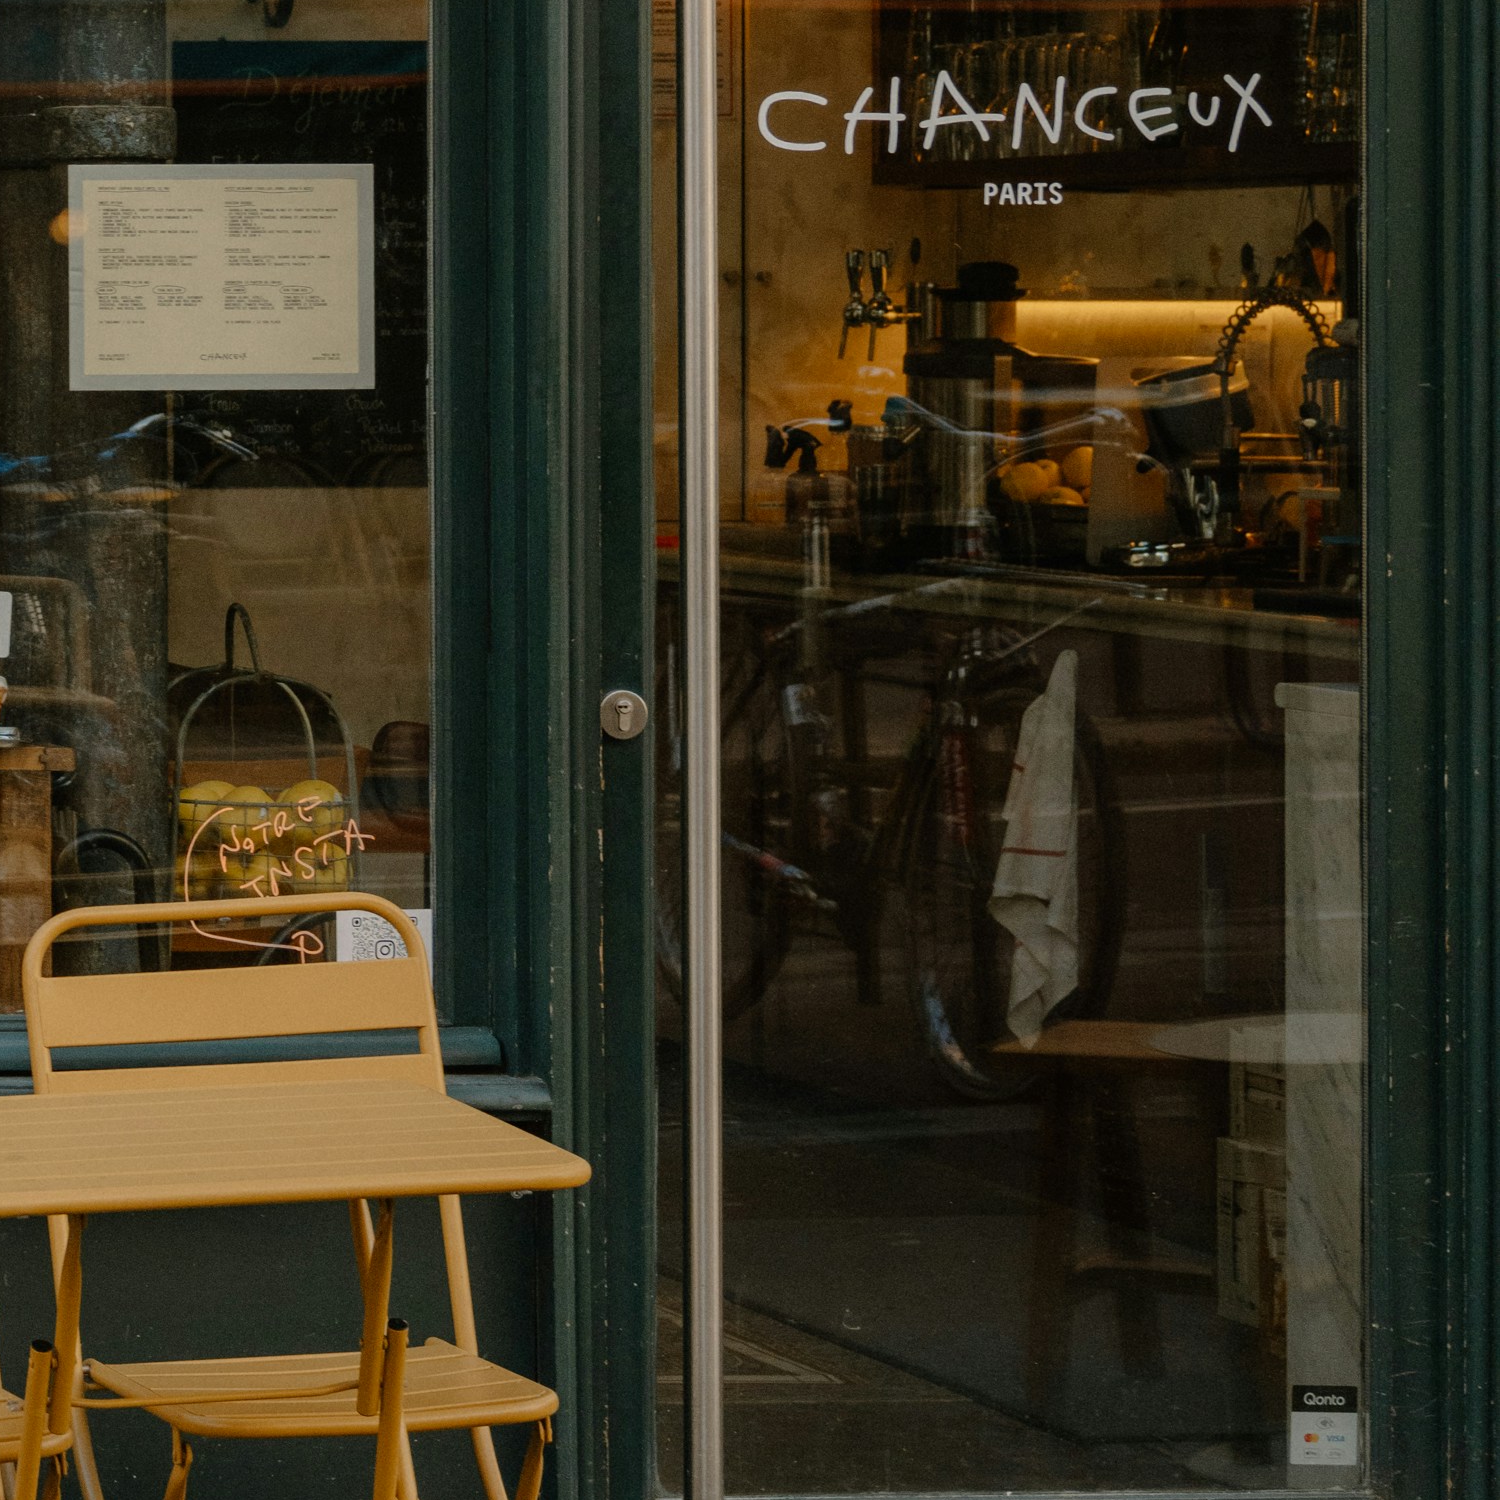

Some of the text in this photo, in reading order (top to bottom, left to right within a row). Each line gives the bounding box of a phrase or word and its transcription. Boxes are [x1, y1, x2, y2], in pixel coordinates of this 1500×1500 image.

[756, 69, 1273, 156] CHANCEUX
[982, 181, 1064, 207] PARIS
[240, 818, 376, 898] INSTA
[1303, 1391, 1346, 1406] Qonto
[1326, 1434, 1346, 1442] VISA
